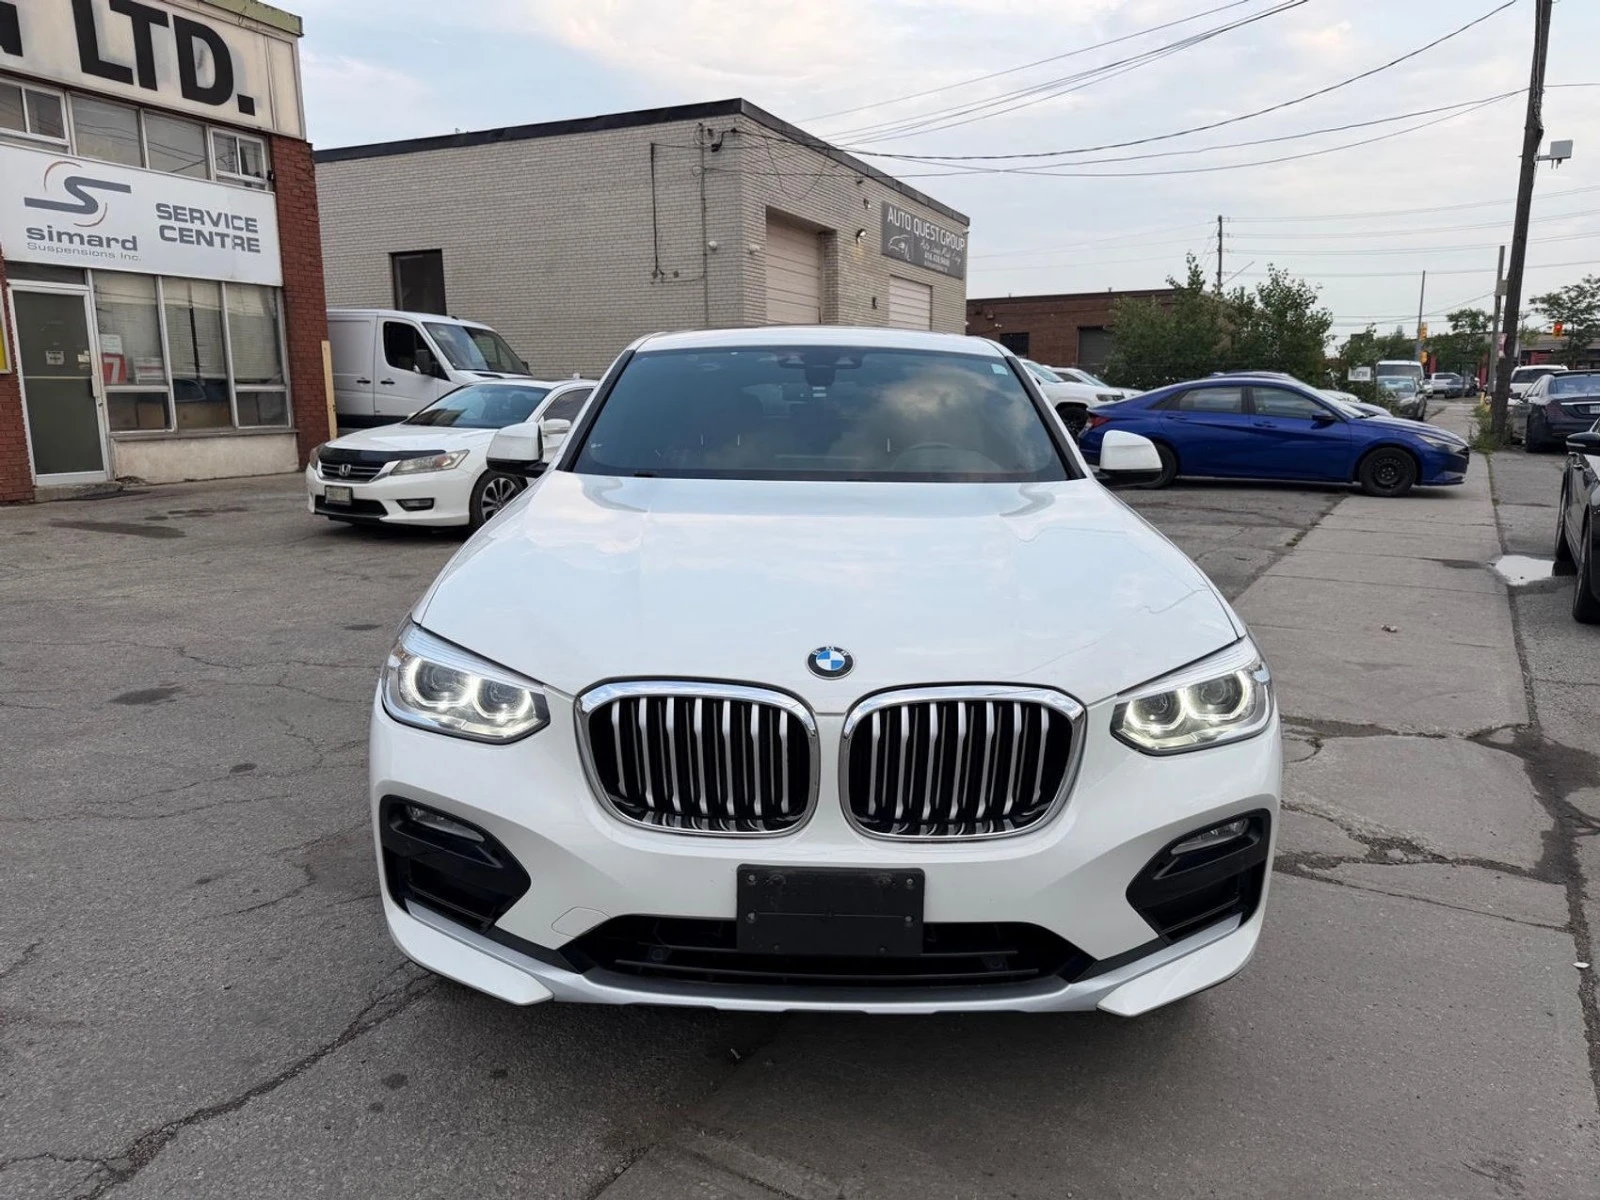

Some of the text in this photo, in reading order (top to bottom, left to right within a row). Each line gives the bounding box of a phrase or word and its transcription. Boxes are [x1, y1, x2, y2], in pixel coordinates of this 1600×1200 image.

[72, 0, 256, 117] LTD.
[155, 202, 259, 234] SERVICE
[887, 206, 966, 252] AUTO QUEST GROUP
[26, 226, 138, 252] simard
[27, 242, 142, 262] Suspensions Inc.
[159, 225, 262, 254] CENTRE
